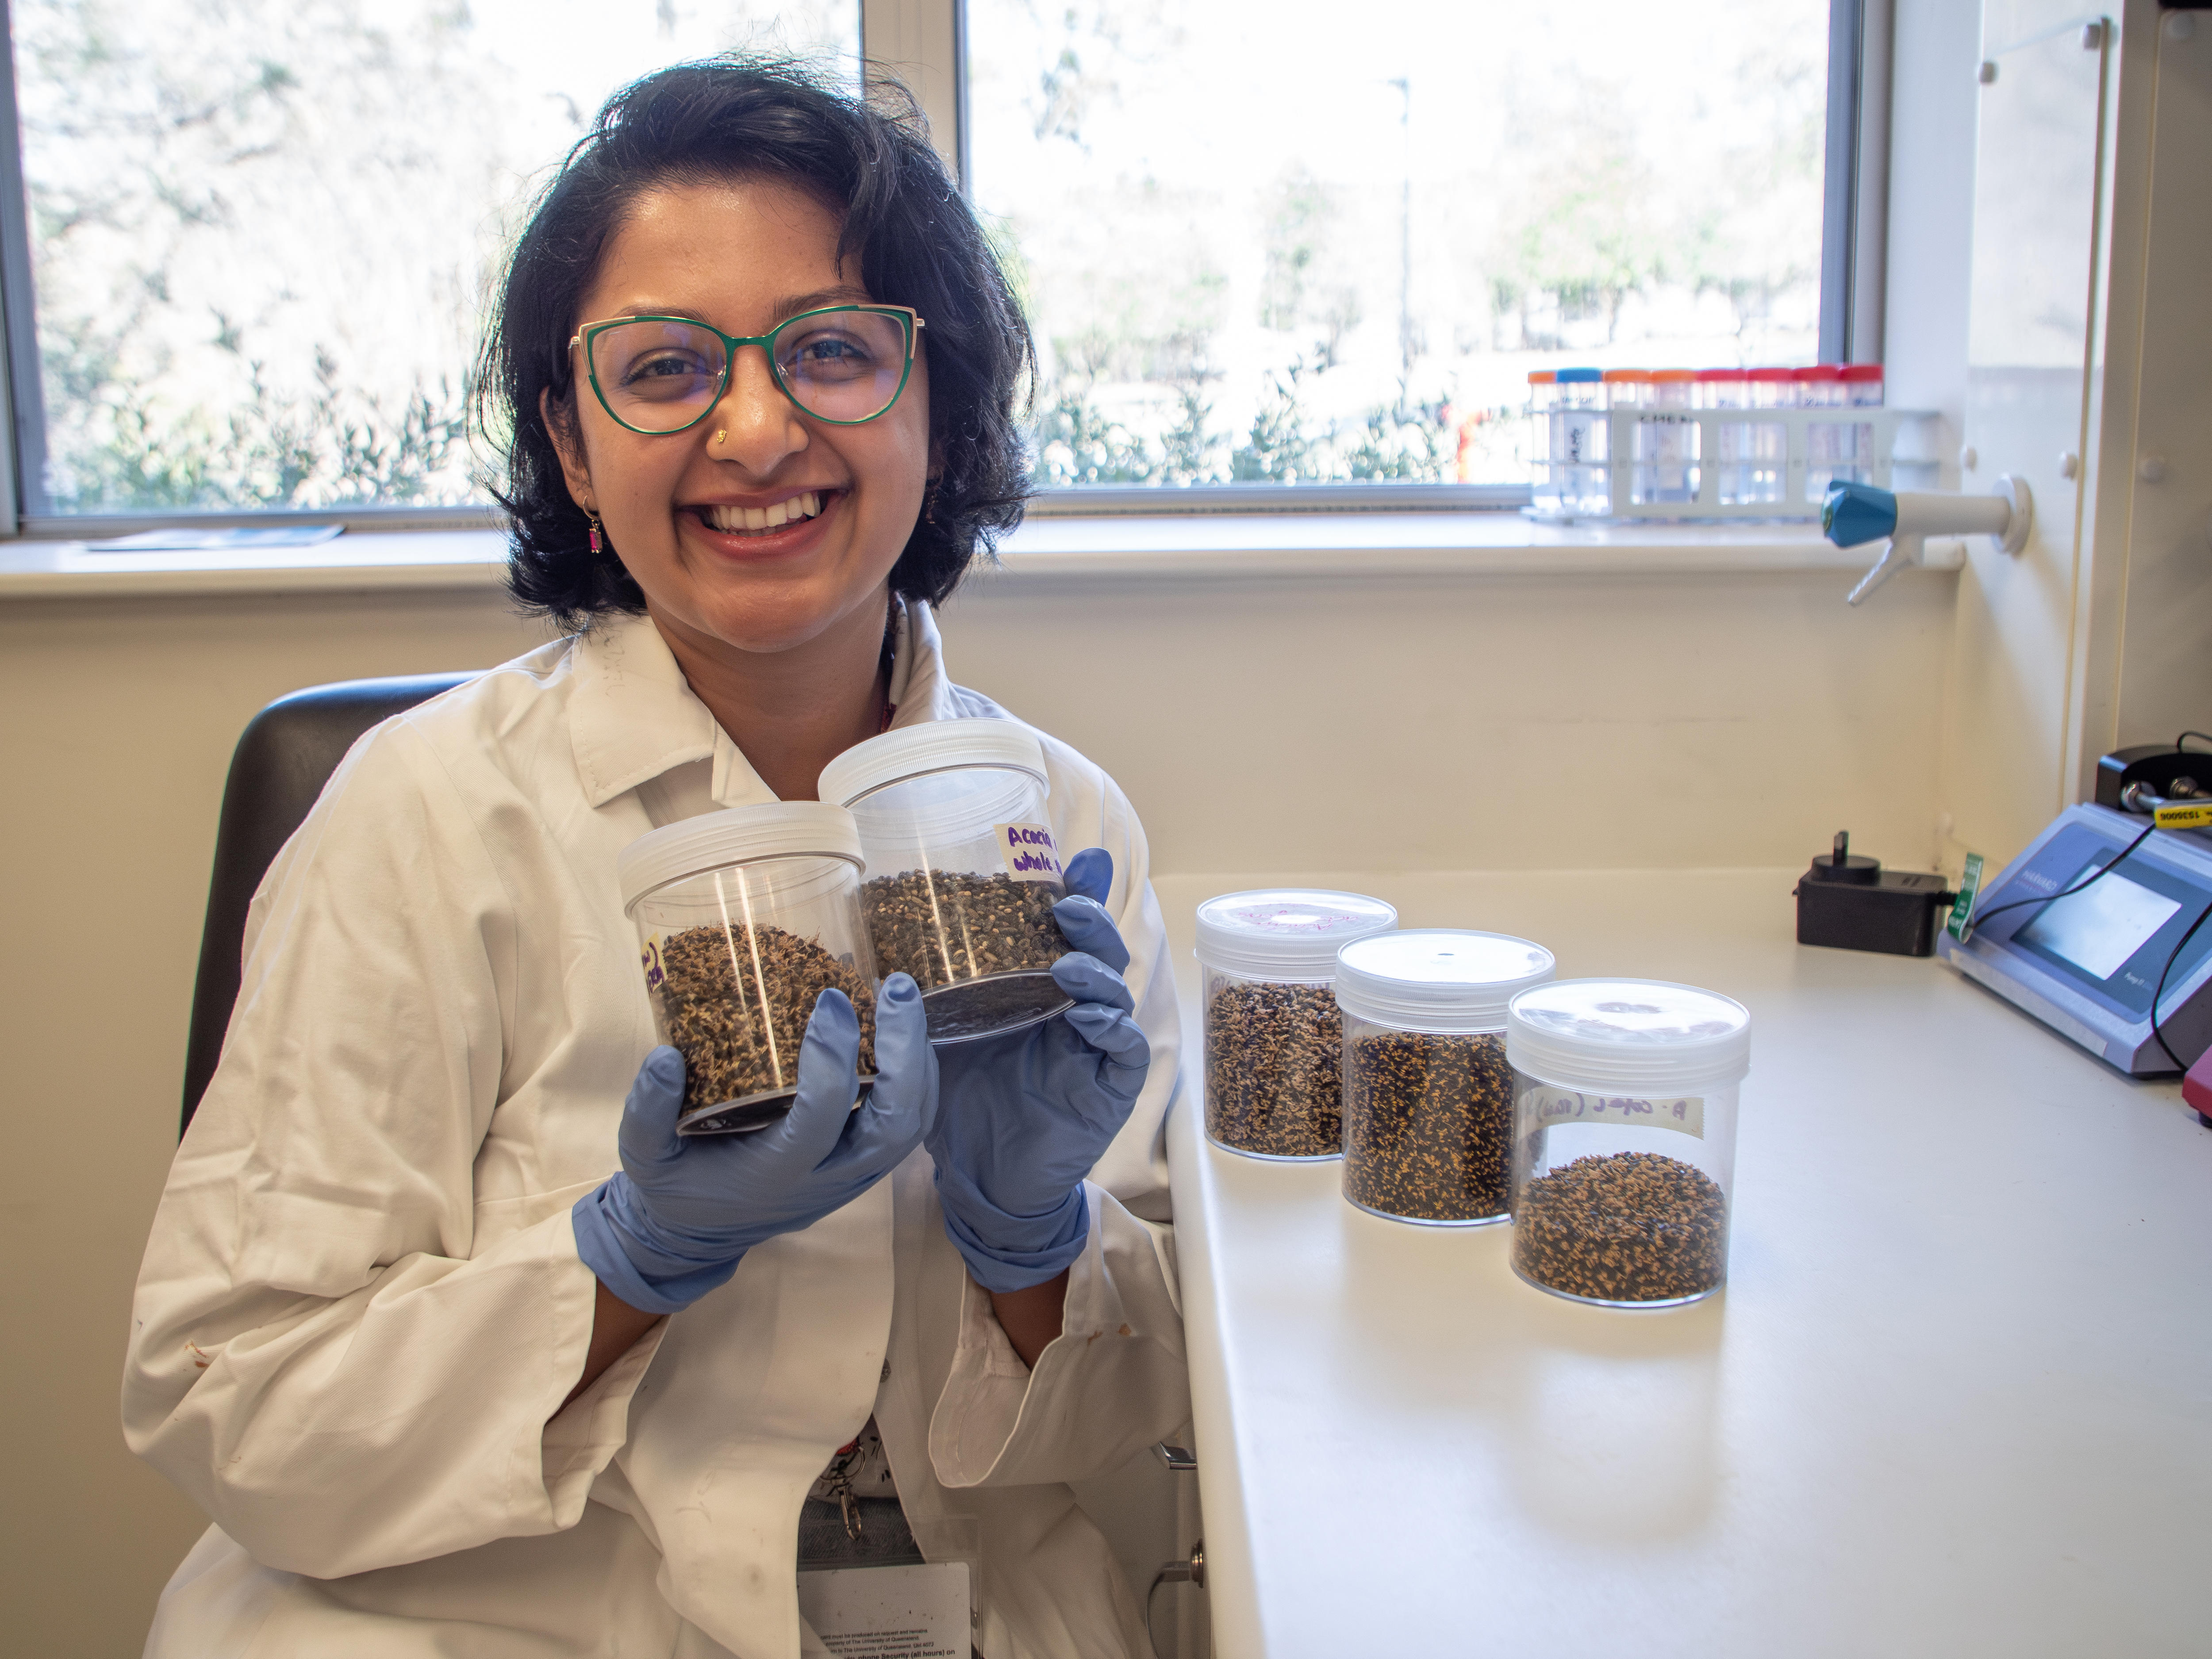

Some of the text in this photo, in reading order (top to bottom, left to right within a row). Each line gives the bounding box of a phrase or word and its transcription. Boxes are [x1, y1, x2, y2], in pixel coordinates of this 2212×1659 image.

[1008, 826, 1053, 849] Acacia
[1013, 851, 1053, 871] whole
[911, 1651, 921, 1659] (all
